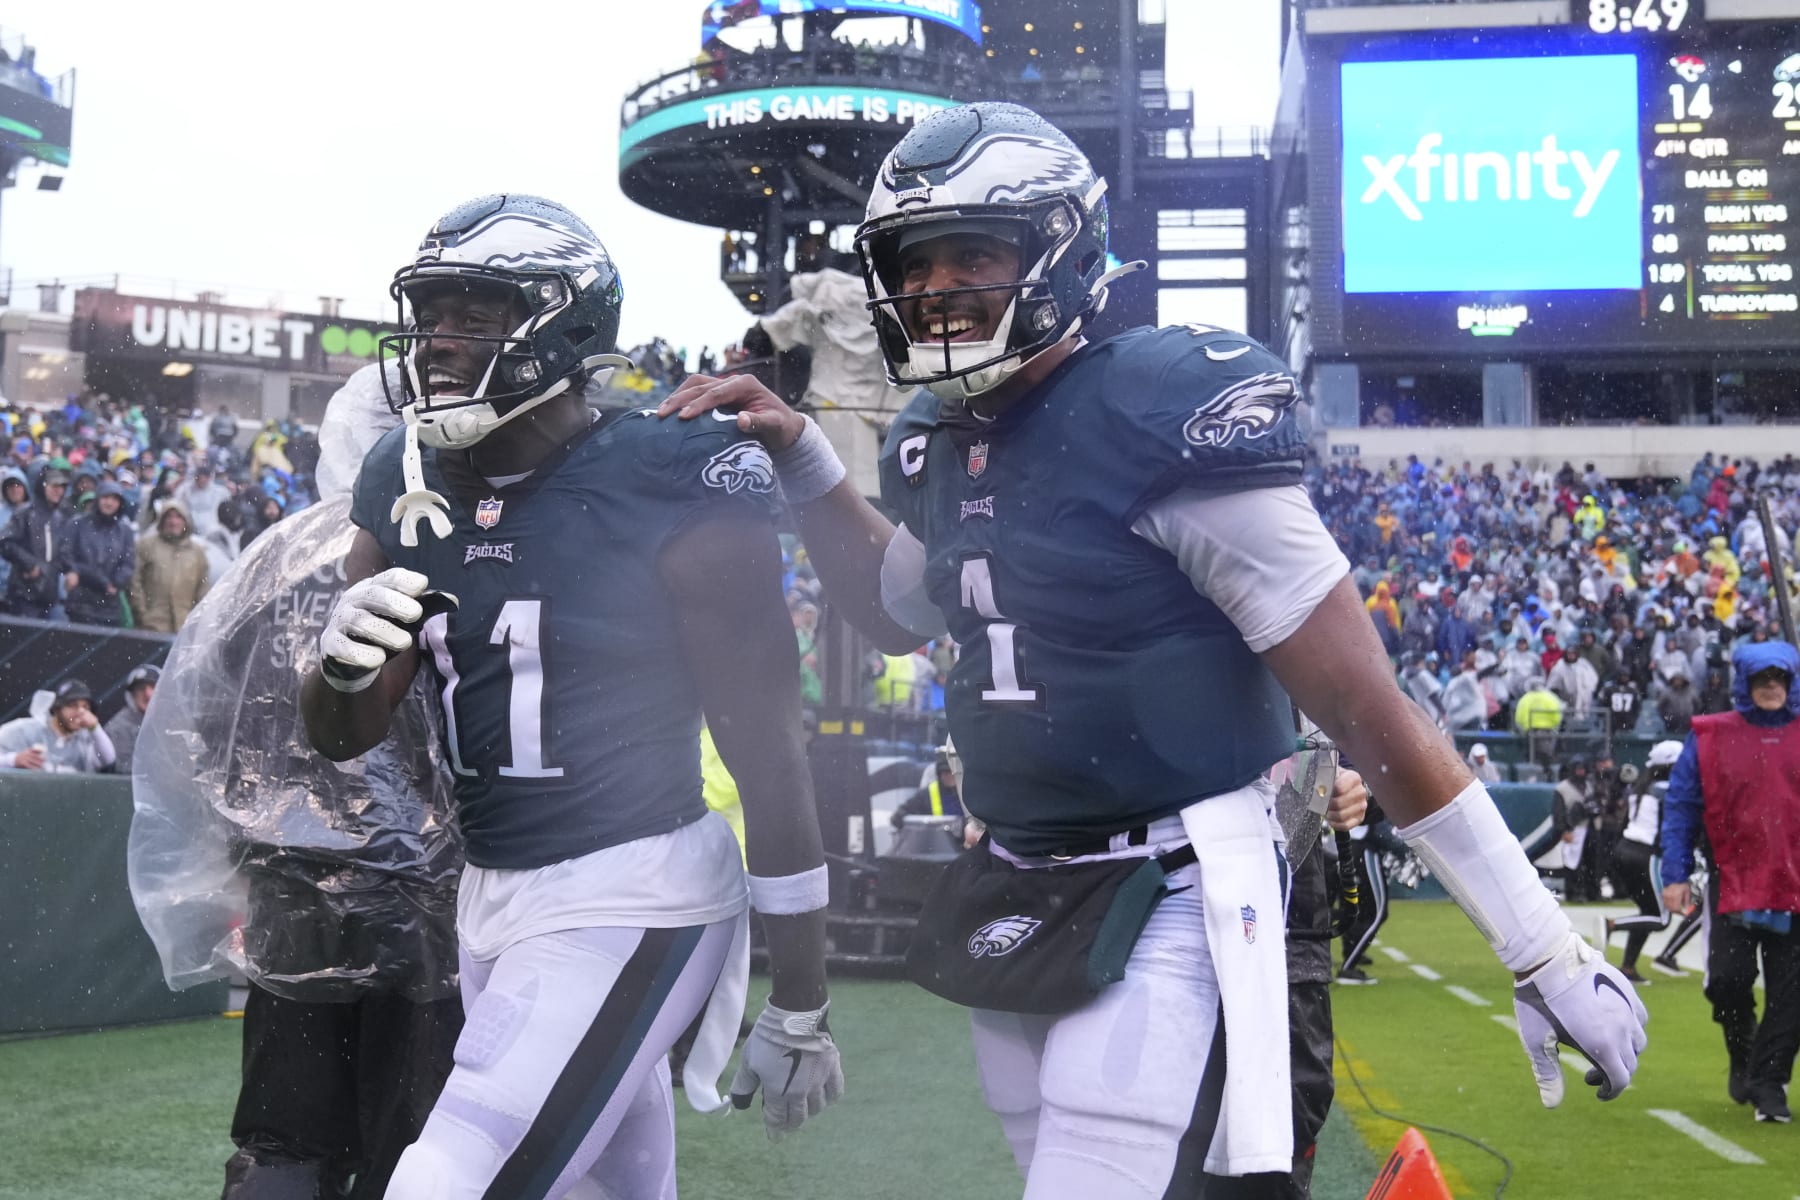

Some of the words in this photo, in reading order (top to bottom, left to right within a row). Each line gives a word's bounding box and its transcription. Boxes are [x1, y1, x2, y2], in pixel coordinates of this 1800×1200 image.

[1588, 0, 1689, 33] 8:49
[703, 98, 763, 130] THIS
[769, 95, 855, 121] GAME
[862, 96, 890, 123] IS
[1668, 83, 1713, 120] 14
[1772, 81, 1800, 118] 2
[1689, 138, 1729, 158] QTR
[1360, 133, 1621, 221] xfinity
[1685, 169, 1733, 188] BALL
[1736, 168, 1768, 187] ON
[1652, 204, 1675, 224] 71
[1702, 264, 1756, 282] TOTAL
[1659, 293, 1675, 312] 4
[132, 304, 314, 360] UNIBET
[900, 435, 926, 477] C
[960, 495, 995, 522] EAGLES
[464, 543, 515, 565] EAGLES
[960, 558, 1036, 701] 1
[418, 600, 564, 778] 11
